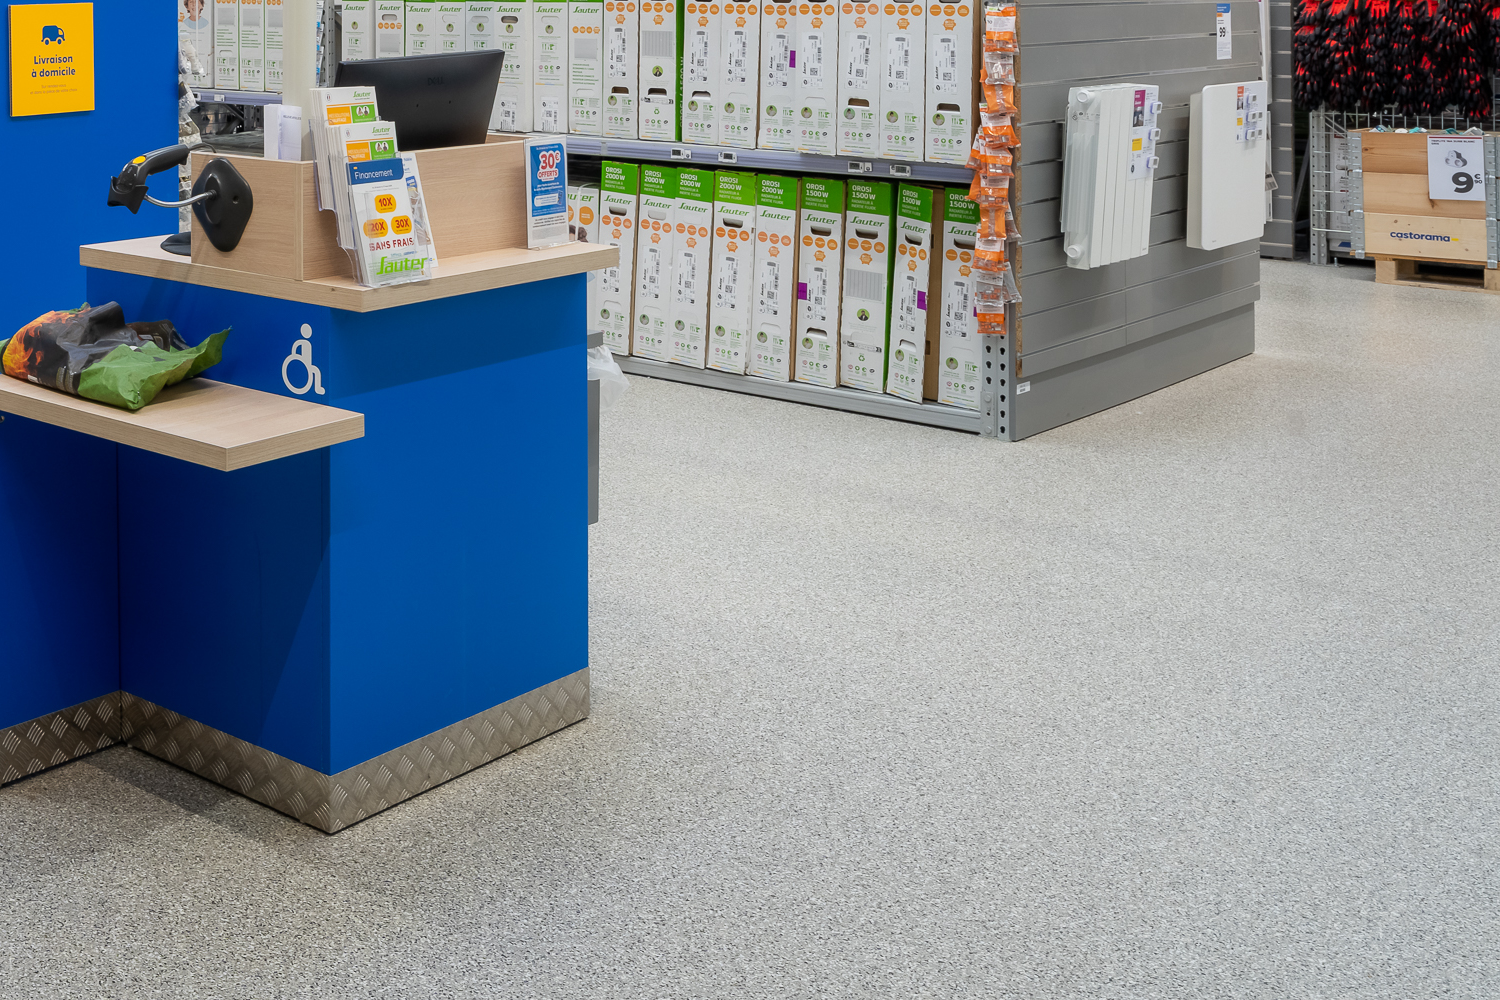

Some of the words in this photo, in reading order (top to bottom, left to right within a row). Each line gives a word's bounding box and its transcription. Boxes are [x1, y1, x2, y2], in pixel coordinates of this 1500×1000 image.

[34, 54, 73, 65] Livraison
[31, 68, 37, 78] à
[39, 67, 76, 77] domicile
[541, 153, 555, 170] 30
[354, 169, 393, 180] Financement
[538, 170, 558, 178] OFFERTS
[1452, 172, 1473, 193] 9
[379, 197, 392, 207] 10X
[604, 195, 632, 205] Sauter
[718, 206, 750, 216] Sauter
[395, 219, 409, 228] 30X
[804, 214, 837, 225] Sauter
[850, 216, 885, 227] Sauter
[901, 222, 927, 234] Sauter
[1390, 231, 1450, 242] castorama
[369, 240, 390, 251] SANS
[392, 238, 414, 249] FRAIS
[376, 256, 428, 275] Sauter
